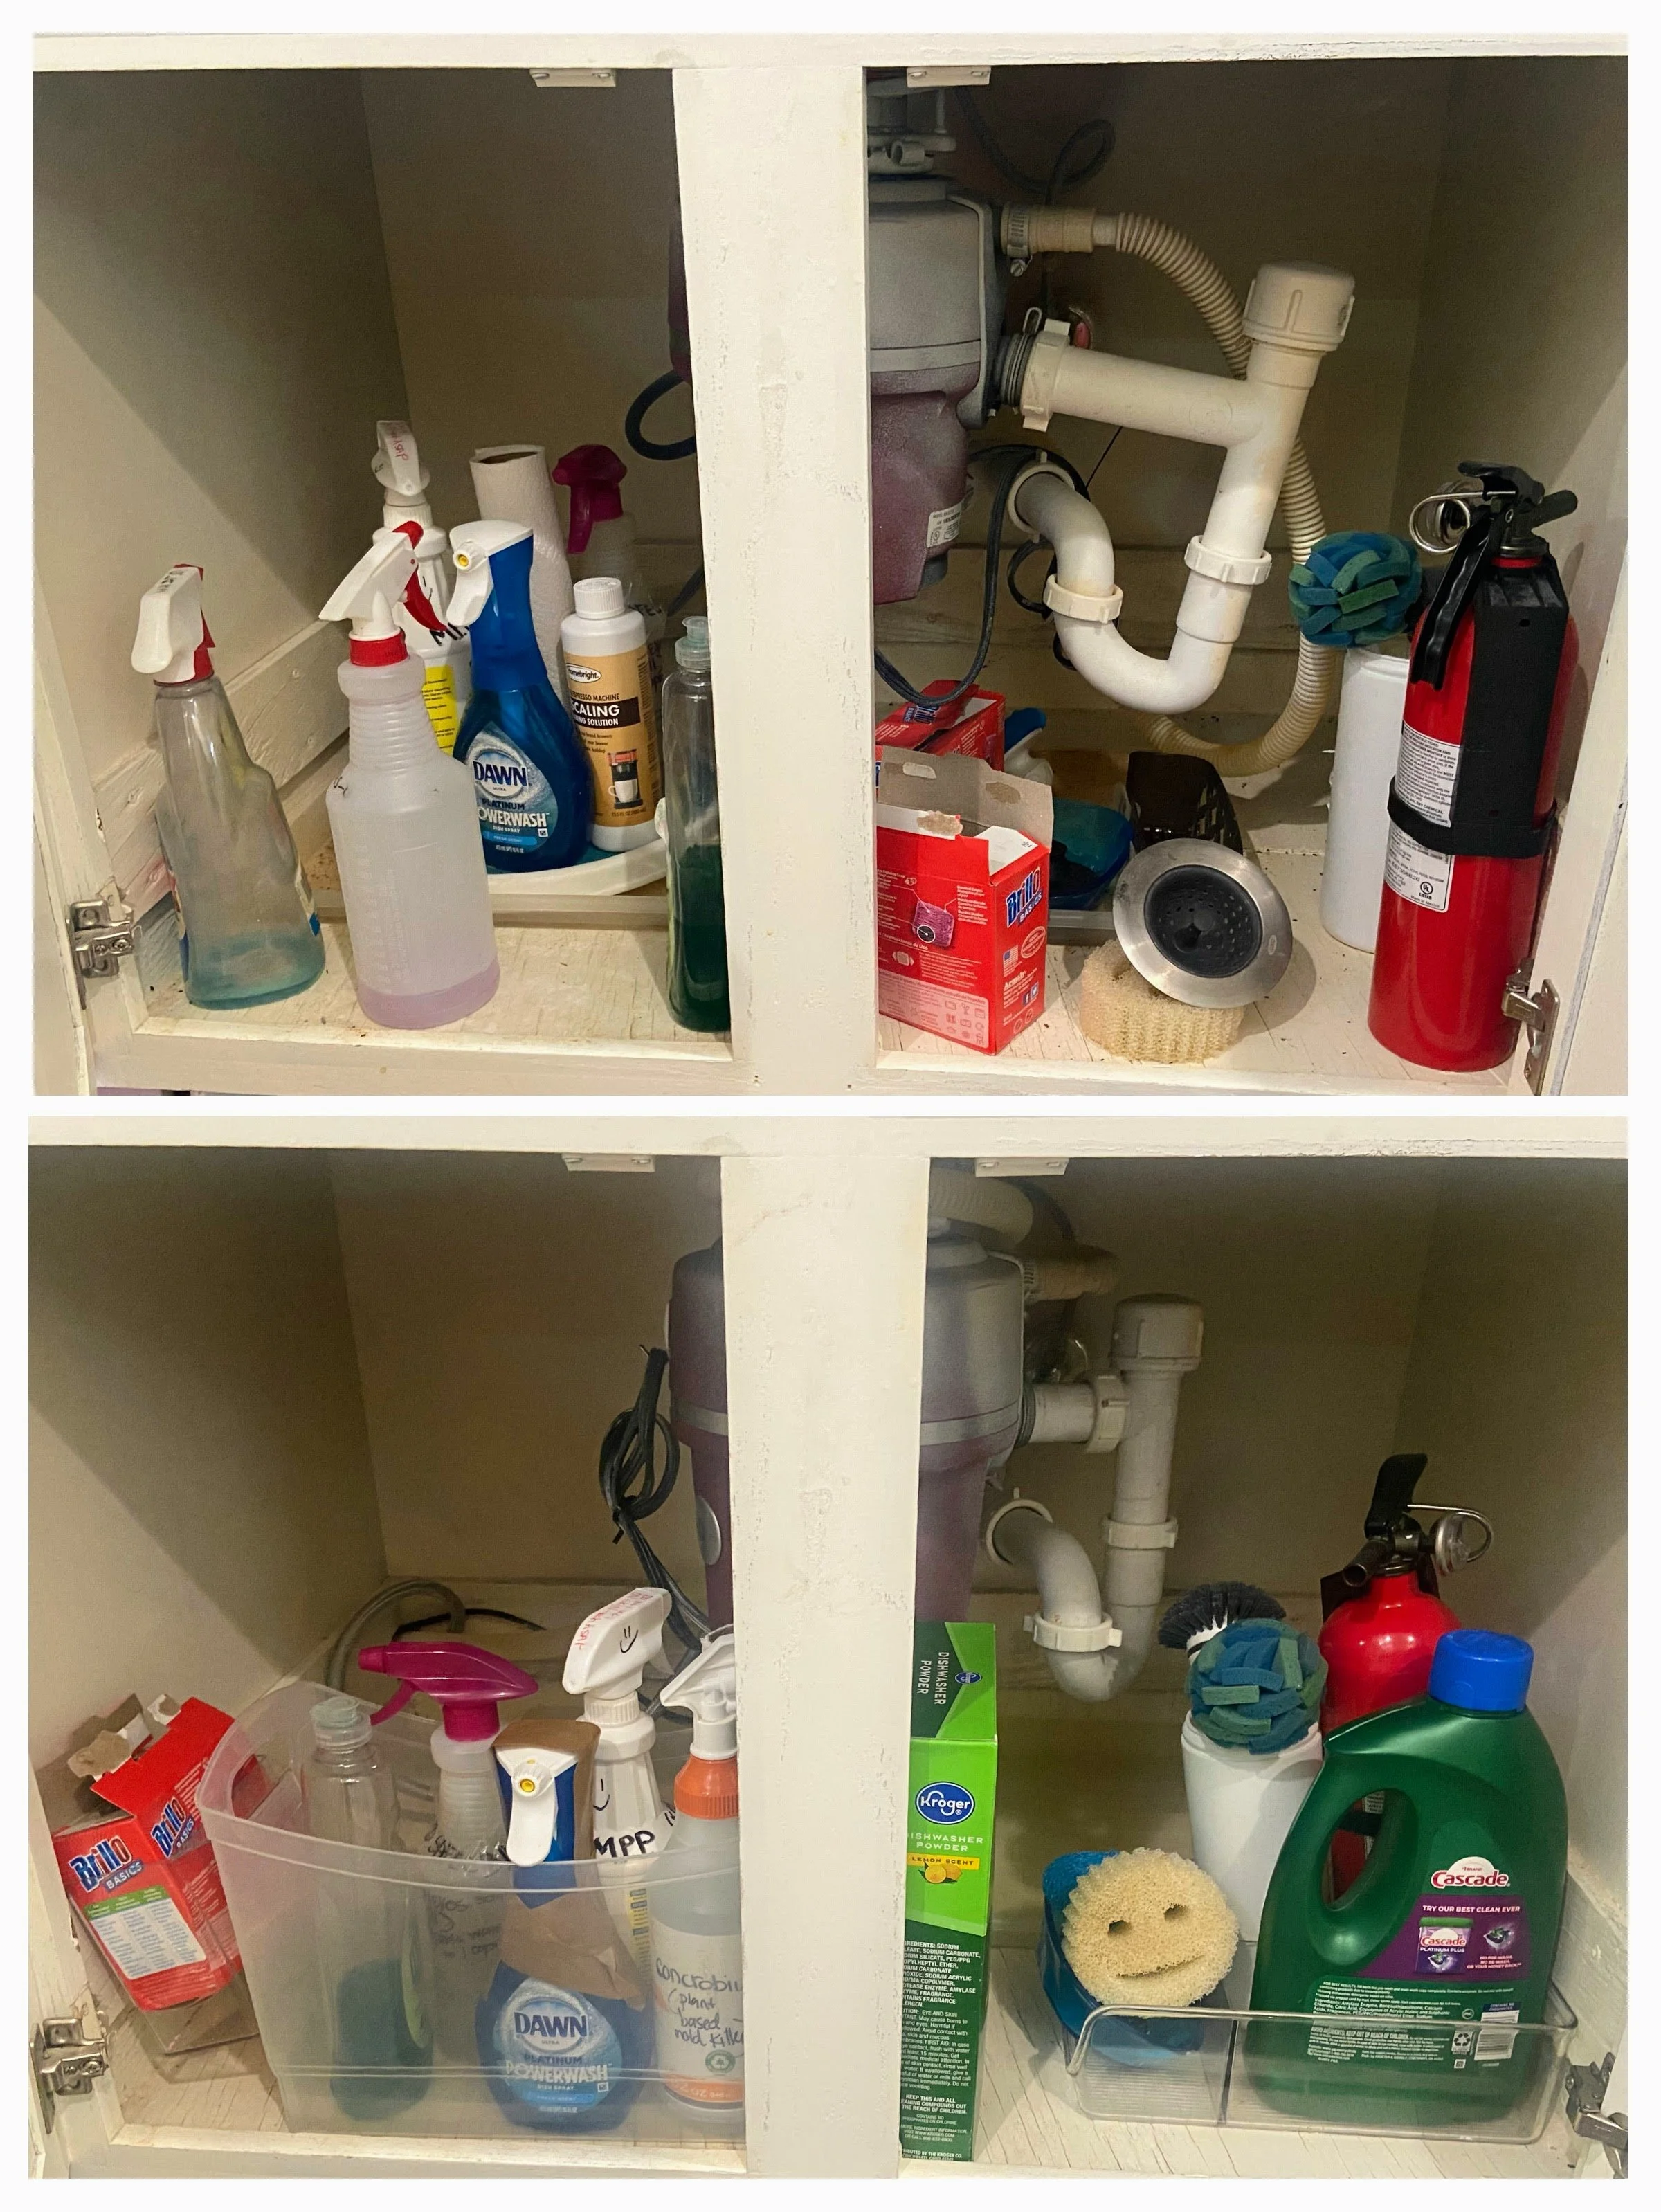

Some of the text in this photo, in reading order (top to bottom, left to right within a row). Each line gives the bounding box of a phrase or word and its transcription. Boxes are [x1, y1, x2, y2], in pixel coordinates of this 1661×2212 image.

[473, 761, 527, 786] DAWN
[482, 798, 525, 810] PLATINUM
[1006, 867, 1040, 928] Brillo
[1019, 891, 1042, 923] BASICS
[917, 1660, 932, 1694] POWDER
[934, 1652, 950, 1705] DISHWASHER
[920, 1791, 970, 1816] Kroger
[151, 1796, 186, 1858] Brillo
[176, 1818, 194, 1848] BASICS
[907, 1833, 983, 1844] ISHWASHER
[917, 1842, 968, 1851] POWDER
[69, 1835, 132, 1893] Brillo
[106, 1862, 142, 1889] BASICS
[1432, 1871, 1507, 1887] Cascade
[1421, 1935, 1467, 1947] Cascade
[514, 2012, 588, 2038] DAWN
[678, 2006, 721, 2031] based
[505, 2060, 608, 2083] POWERWASH
[525, 2054, 583, 2065] PLATINUM
